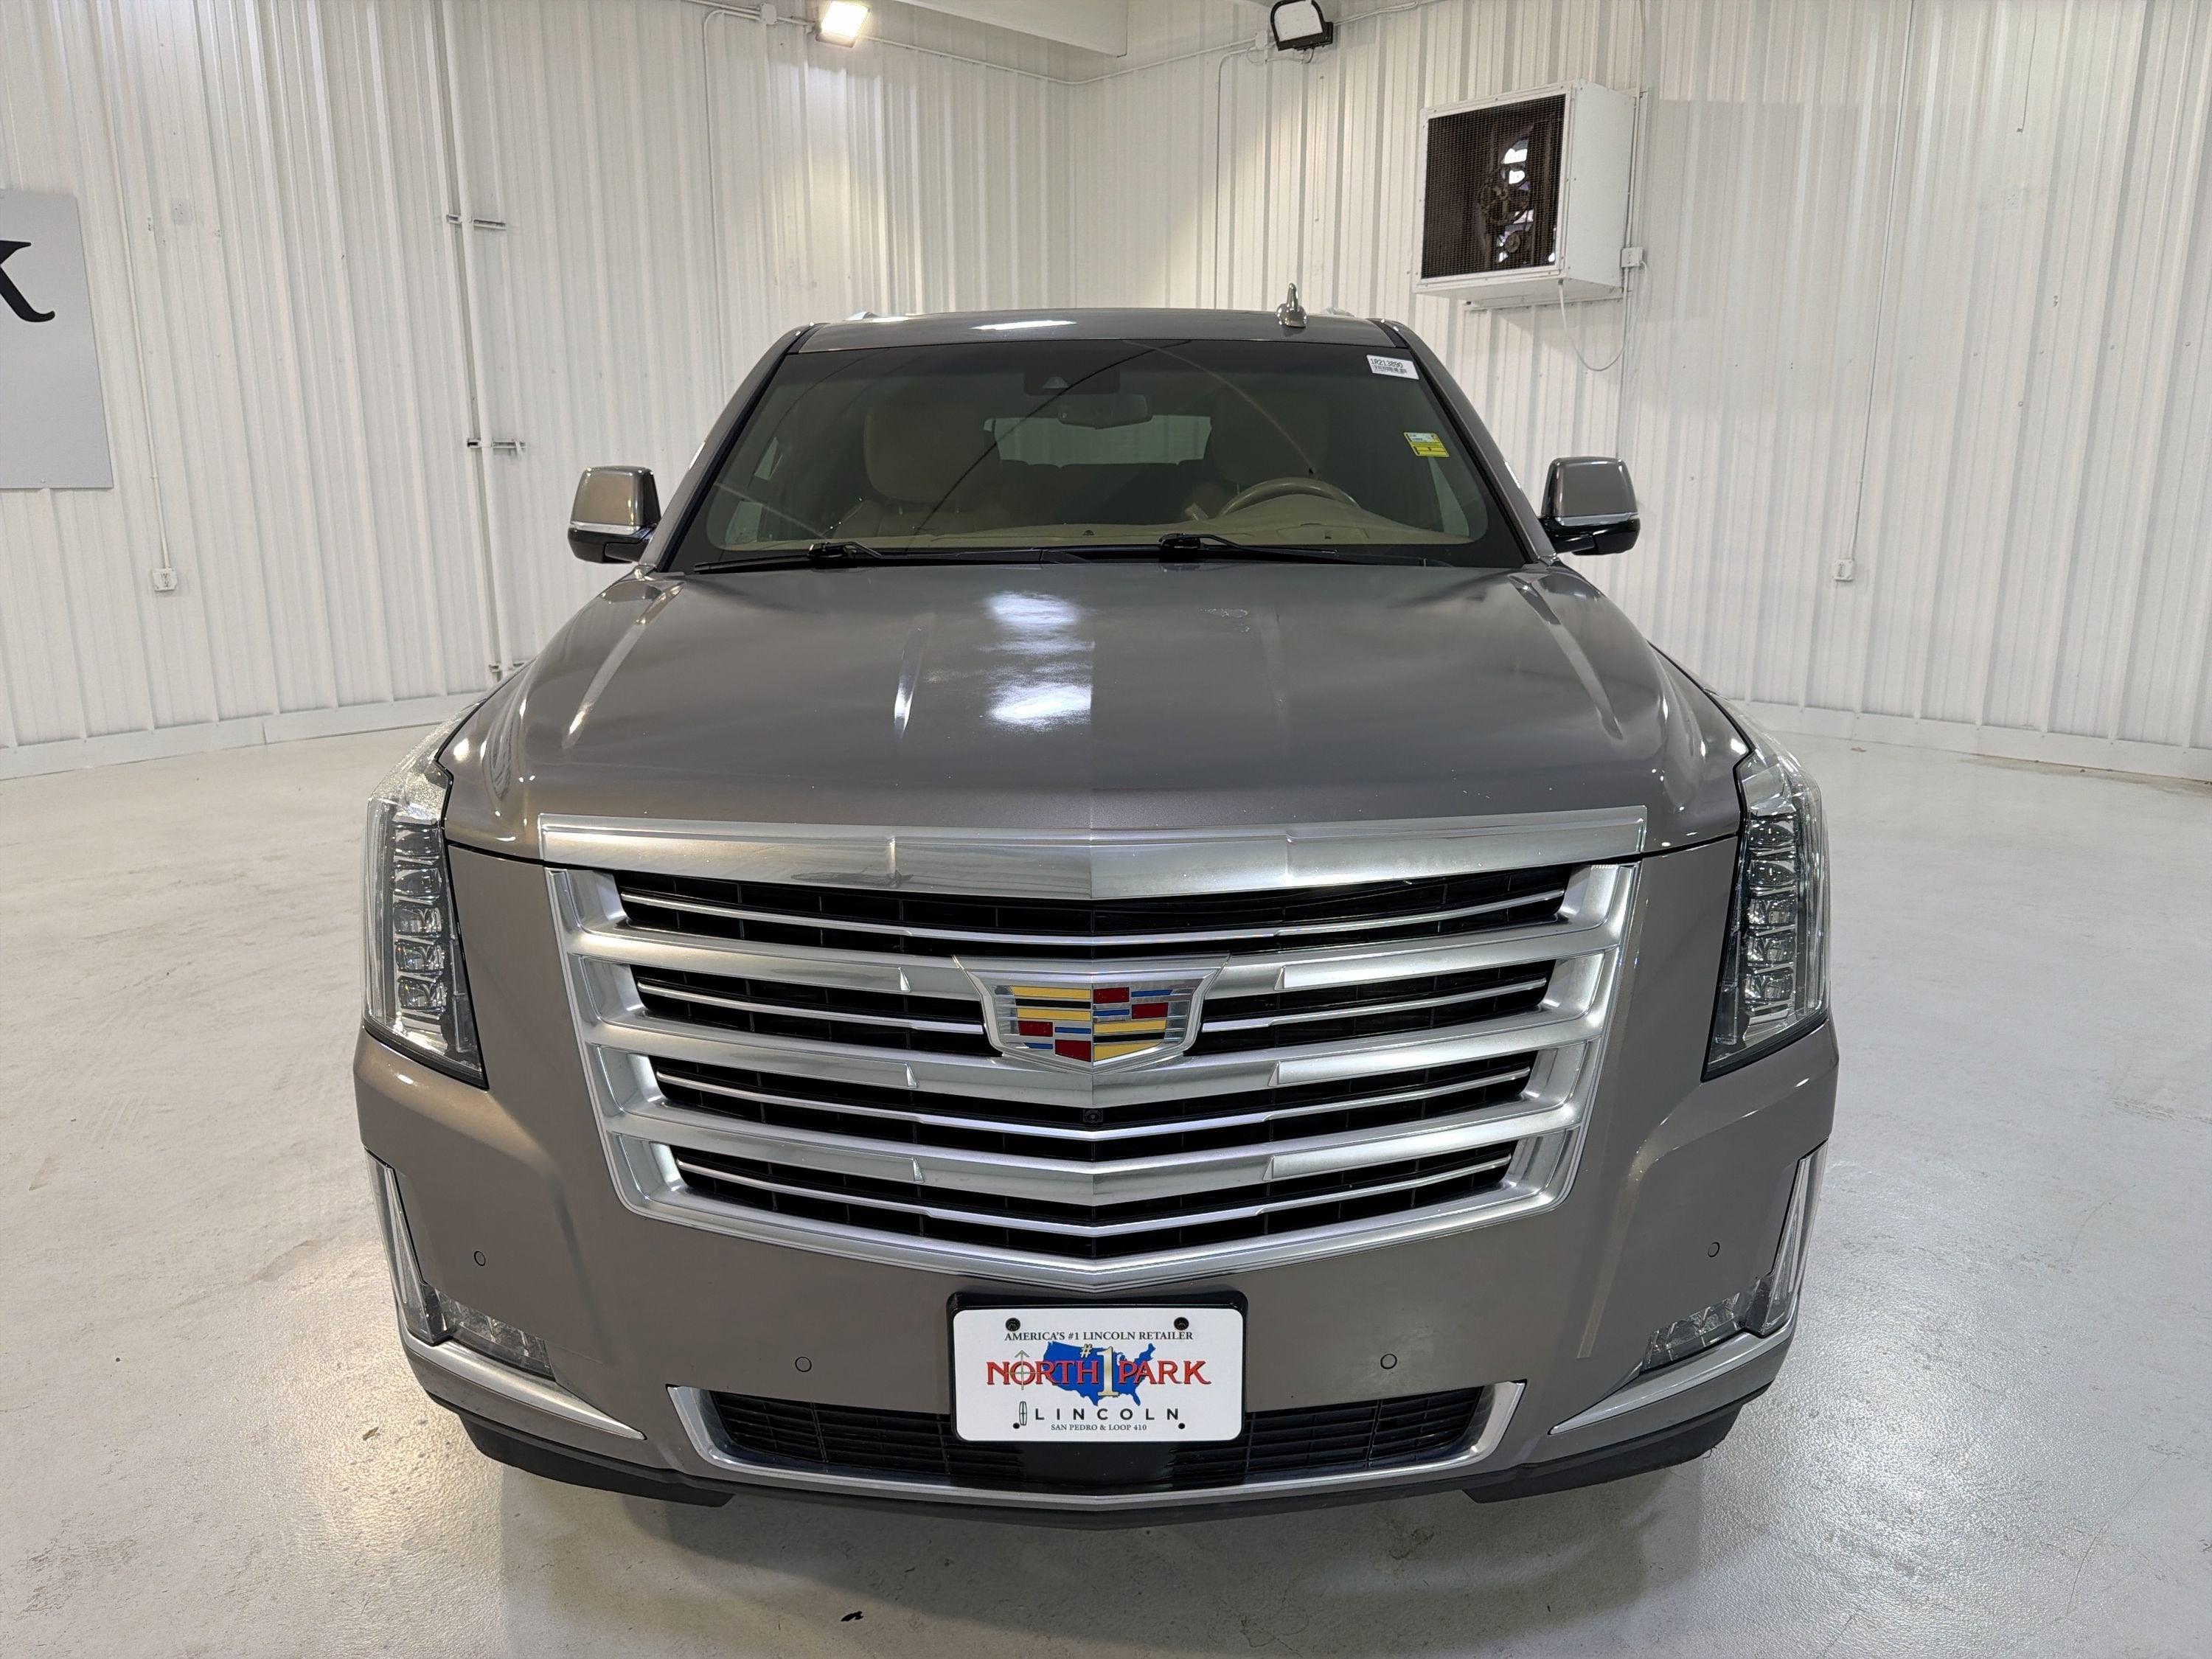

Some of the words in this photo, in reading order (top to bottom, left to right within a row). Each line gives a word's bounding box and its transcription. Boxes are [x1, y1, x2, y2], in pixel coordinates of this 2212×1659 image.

[1004, 1332, 1065, 1340] AMERICA'S
[1068, 1332, 1079, 1340] #1
[1083, 1332, 1135, 1340] LINCOLN
[1138, 1331, 1194, 1340] RETAILER
[986, 1360, 1099, 1385] NORTH
[1118, 1360, 1212, 1385] PARK
[1035, 1408, 1179, 1420] LINCOLN
